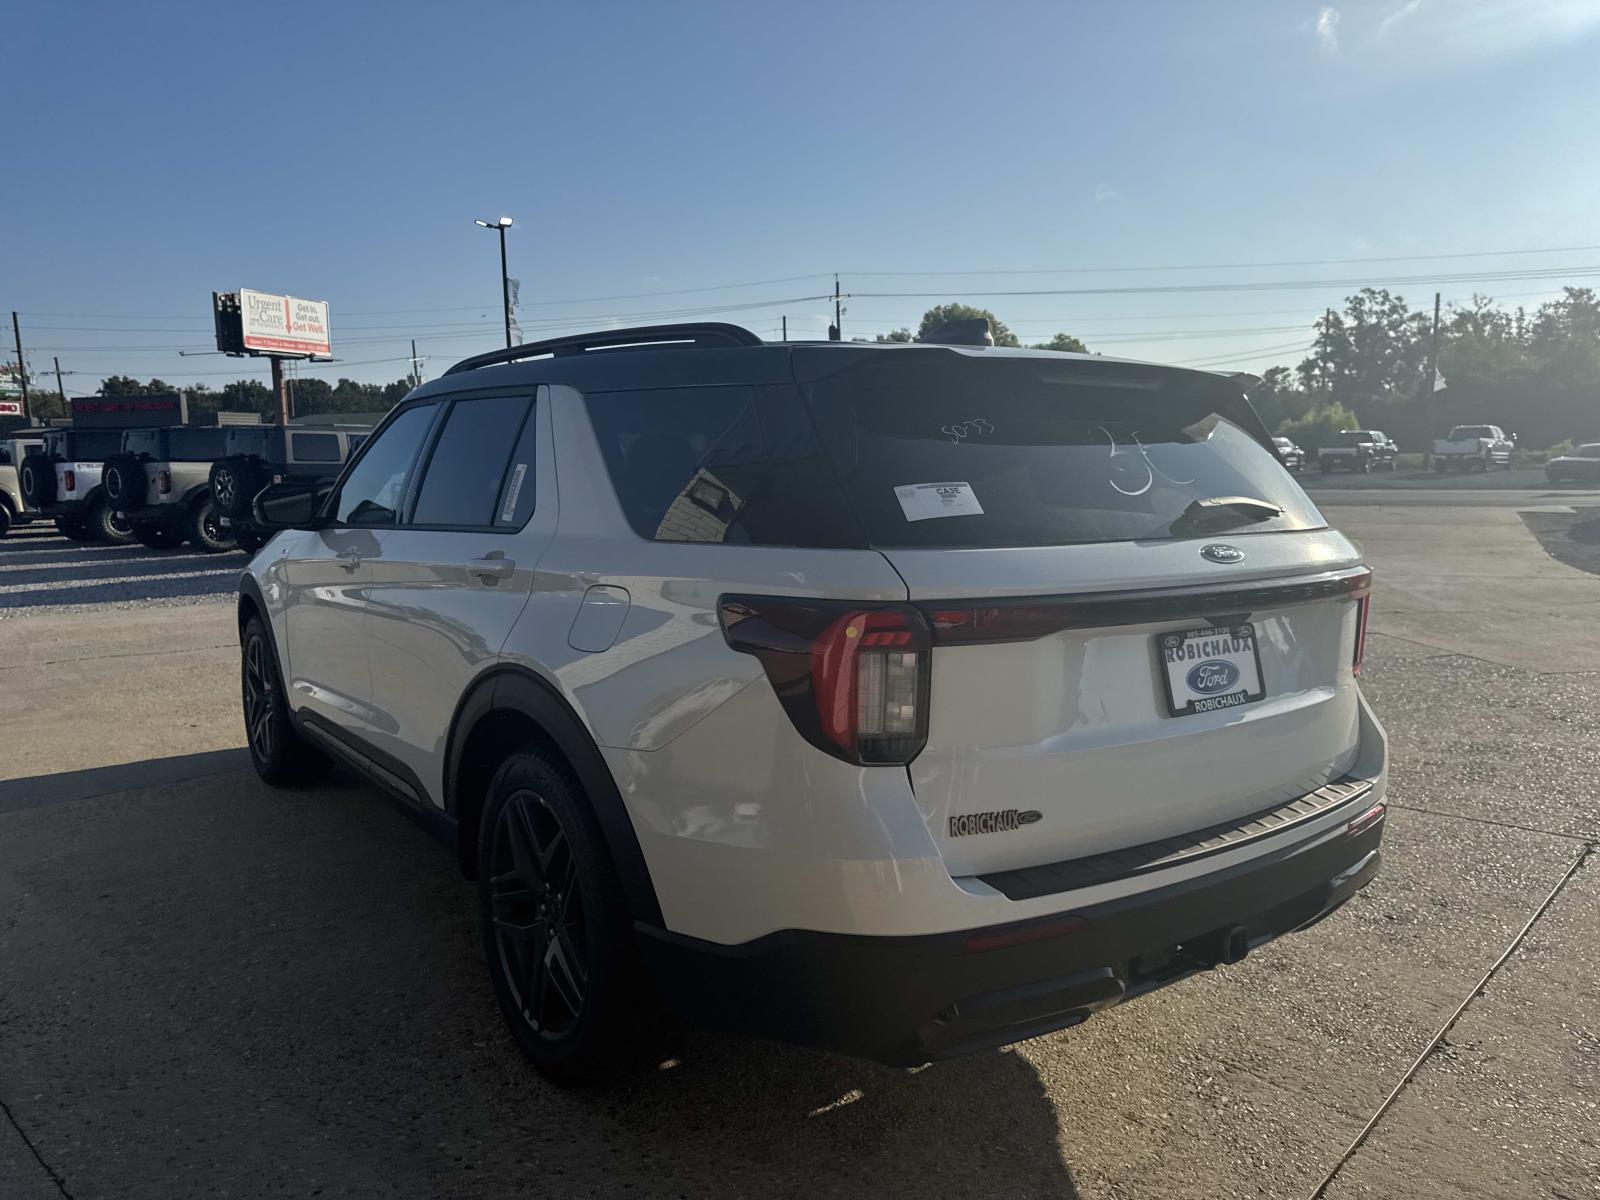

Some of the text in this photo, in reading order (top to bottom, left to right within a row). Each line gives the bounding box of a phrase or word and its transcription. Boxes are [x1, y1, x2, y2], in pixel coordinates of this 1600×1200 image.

[248, 295, 282, 313] Urgent
[297, 303, 309, 312] Get
[259, 311, 283, 325] Care
[296, 312, 307, 321] Get
[293, 321, 307, 332] Get
[1166, 637, 1252, 663] ROBICHAUX
[1198, 664, 1229, 689] Ford
[1194, 693, 1246, 713] ROBICHAUX
[950, 809, 1019, 838] ROBICHAUX
